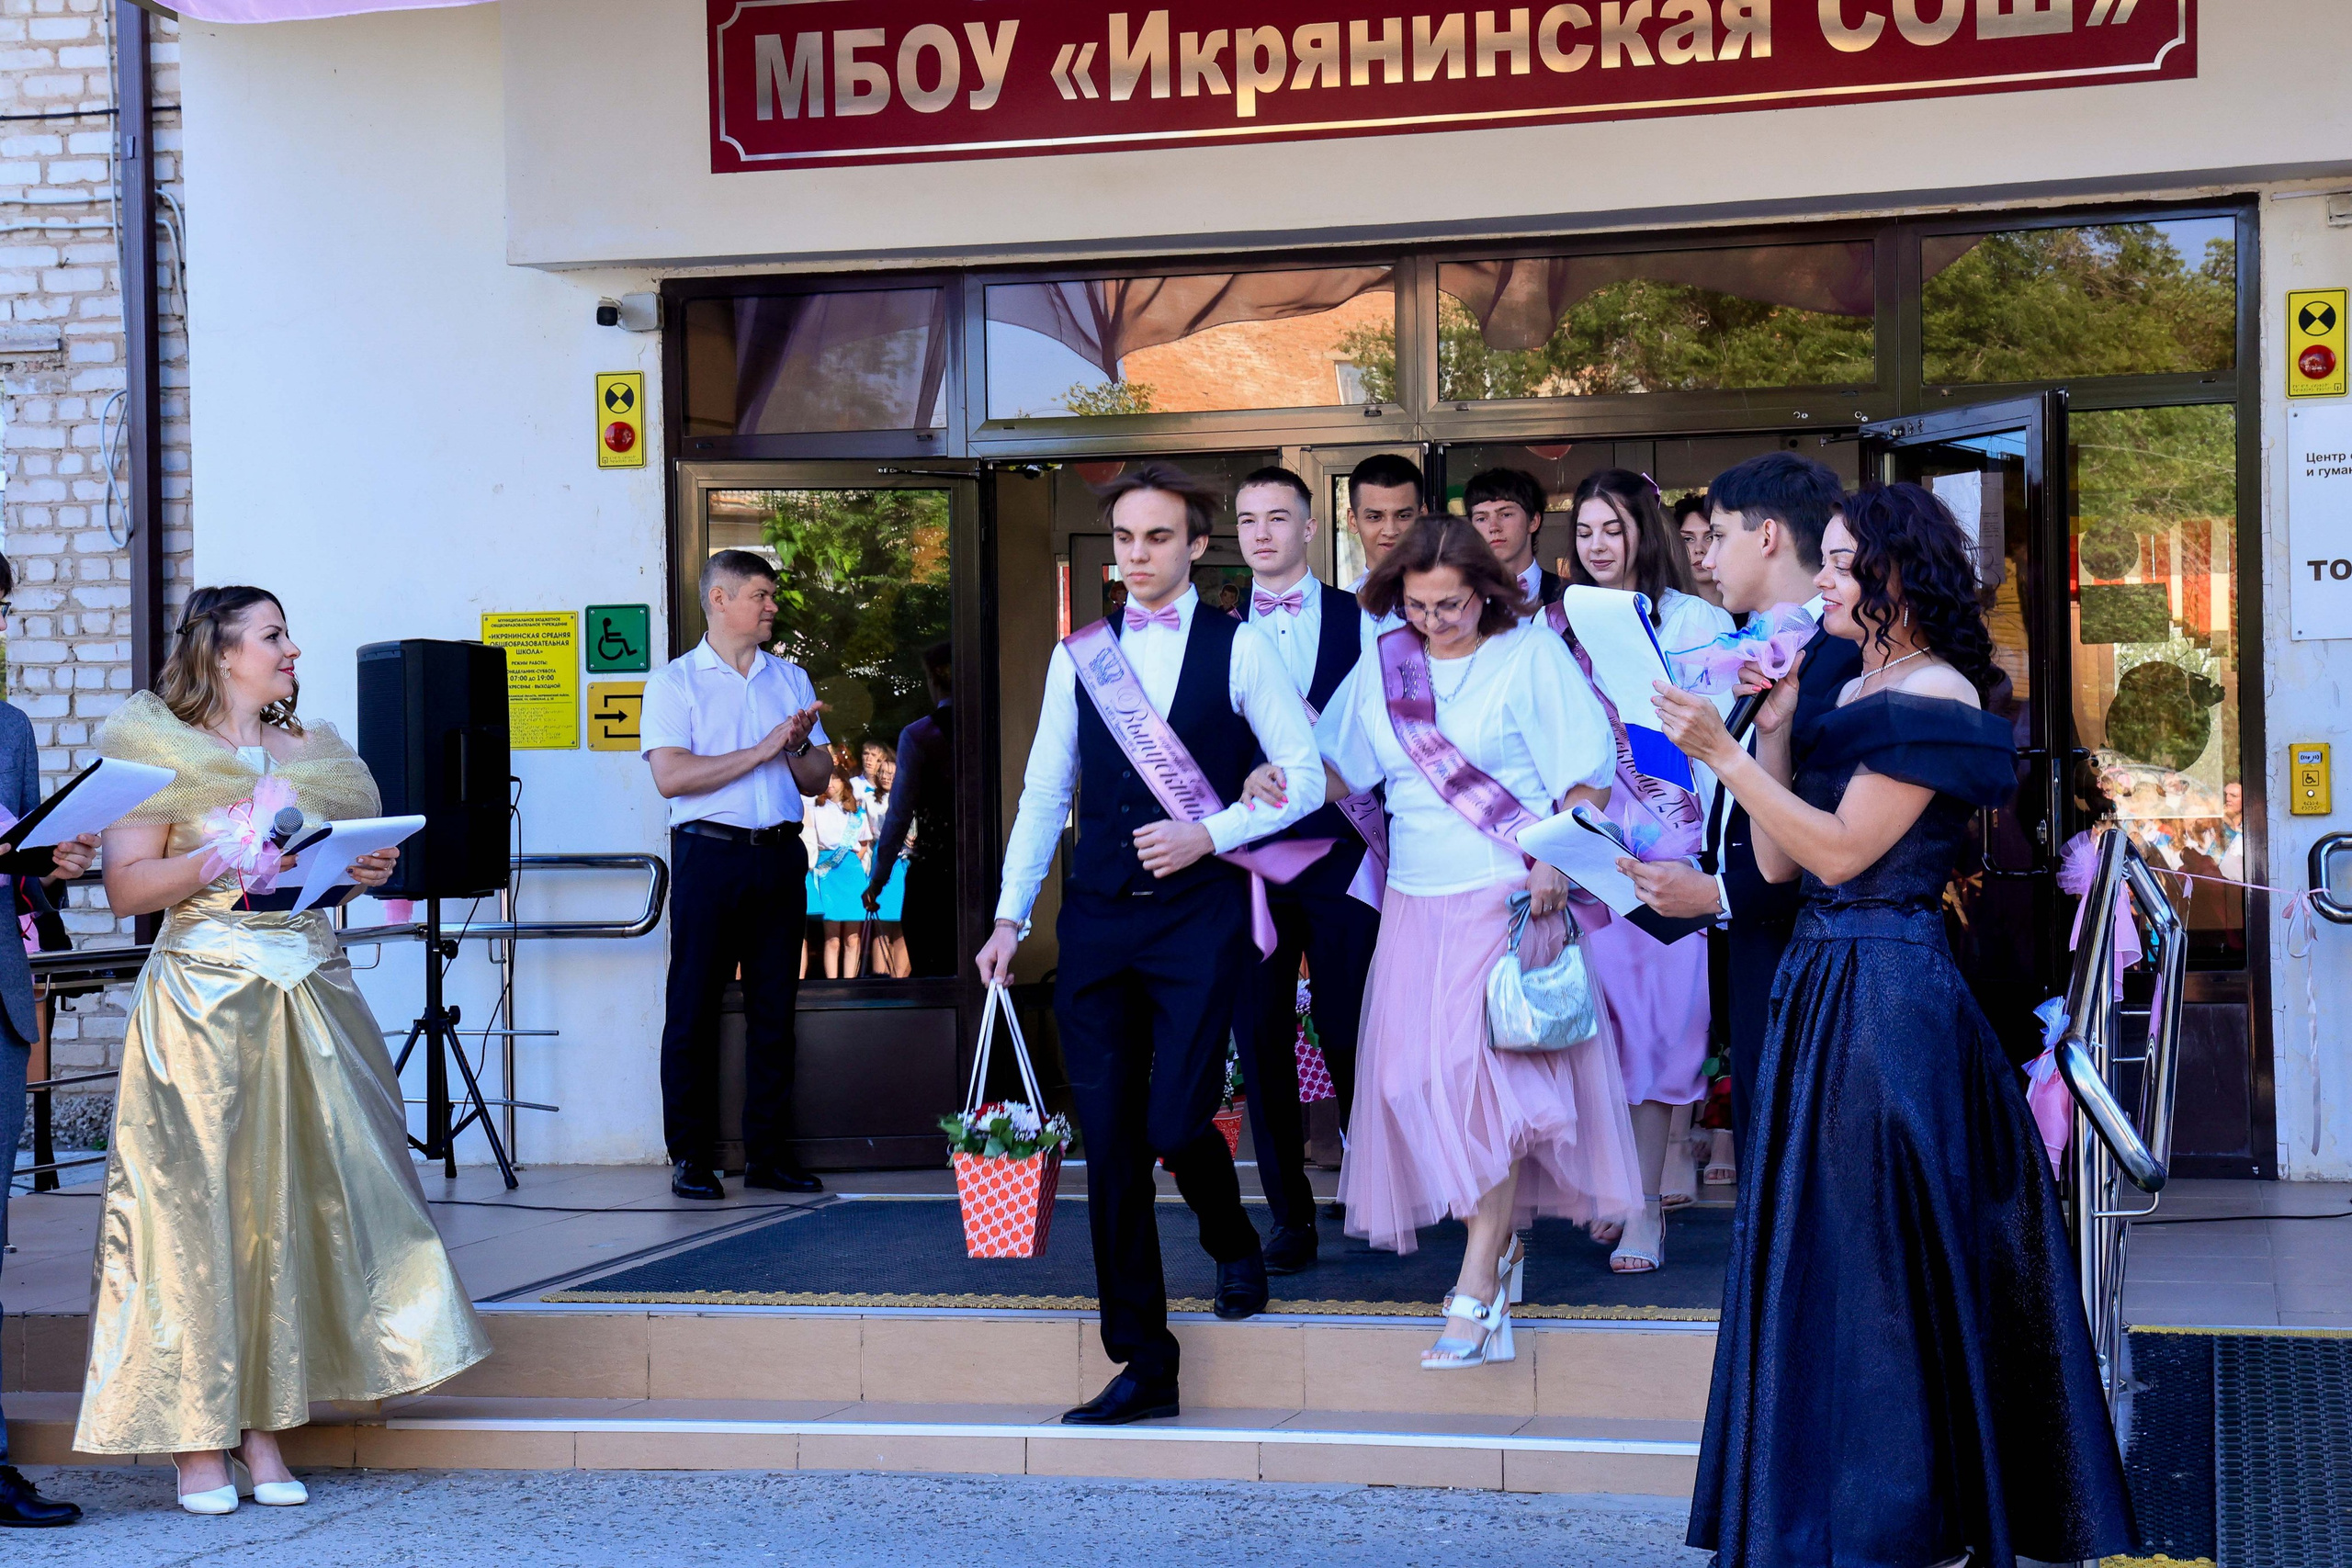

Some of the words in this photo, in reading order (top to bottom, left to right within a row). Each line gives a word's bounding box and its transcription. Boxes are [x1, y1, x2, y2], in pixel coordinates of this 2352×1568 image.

[755, 19, 1020, 120] МБОУ
[1050, 0, 1771, 117] «Икрянинская
[2306, 453, 2346, 464] Центр
[2306, 468, 2313, 477] и
